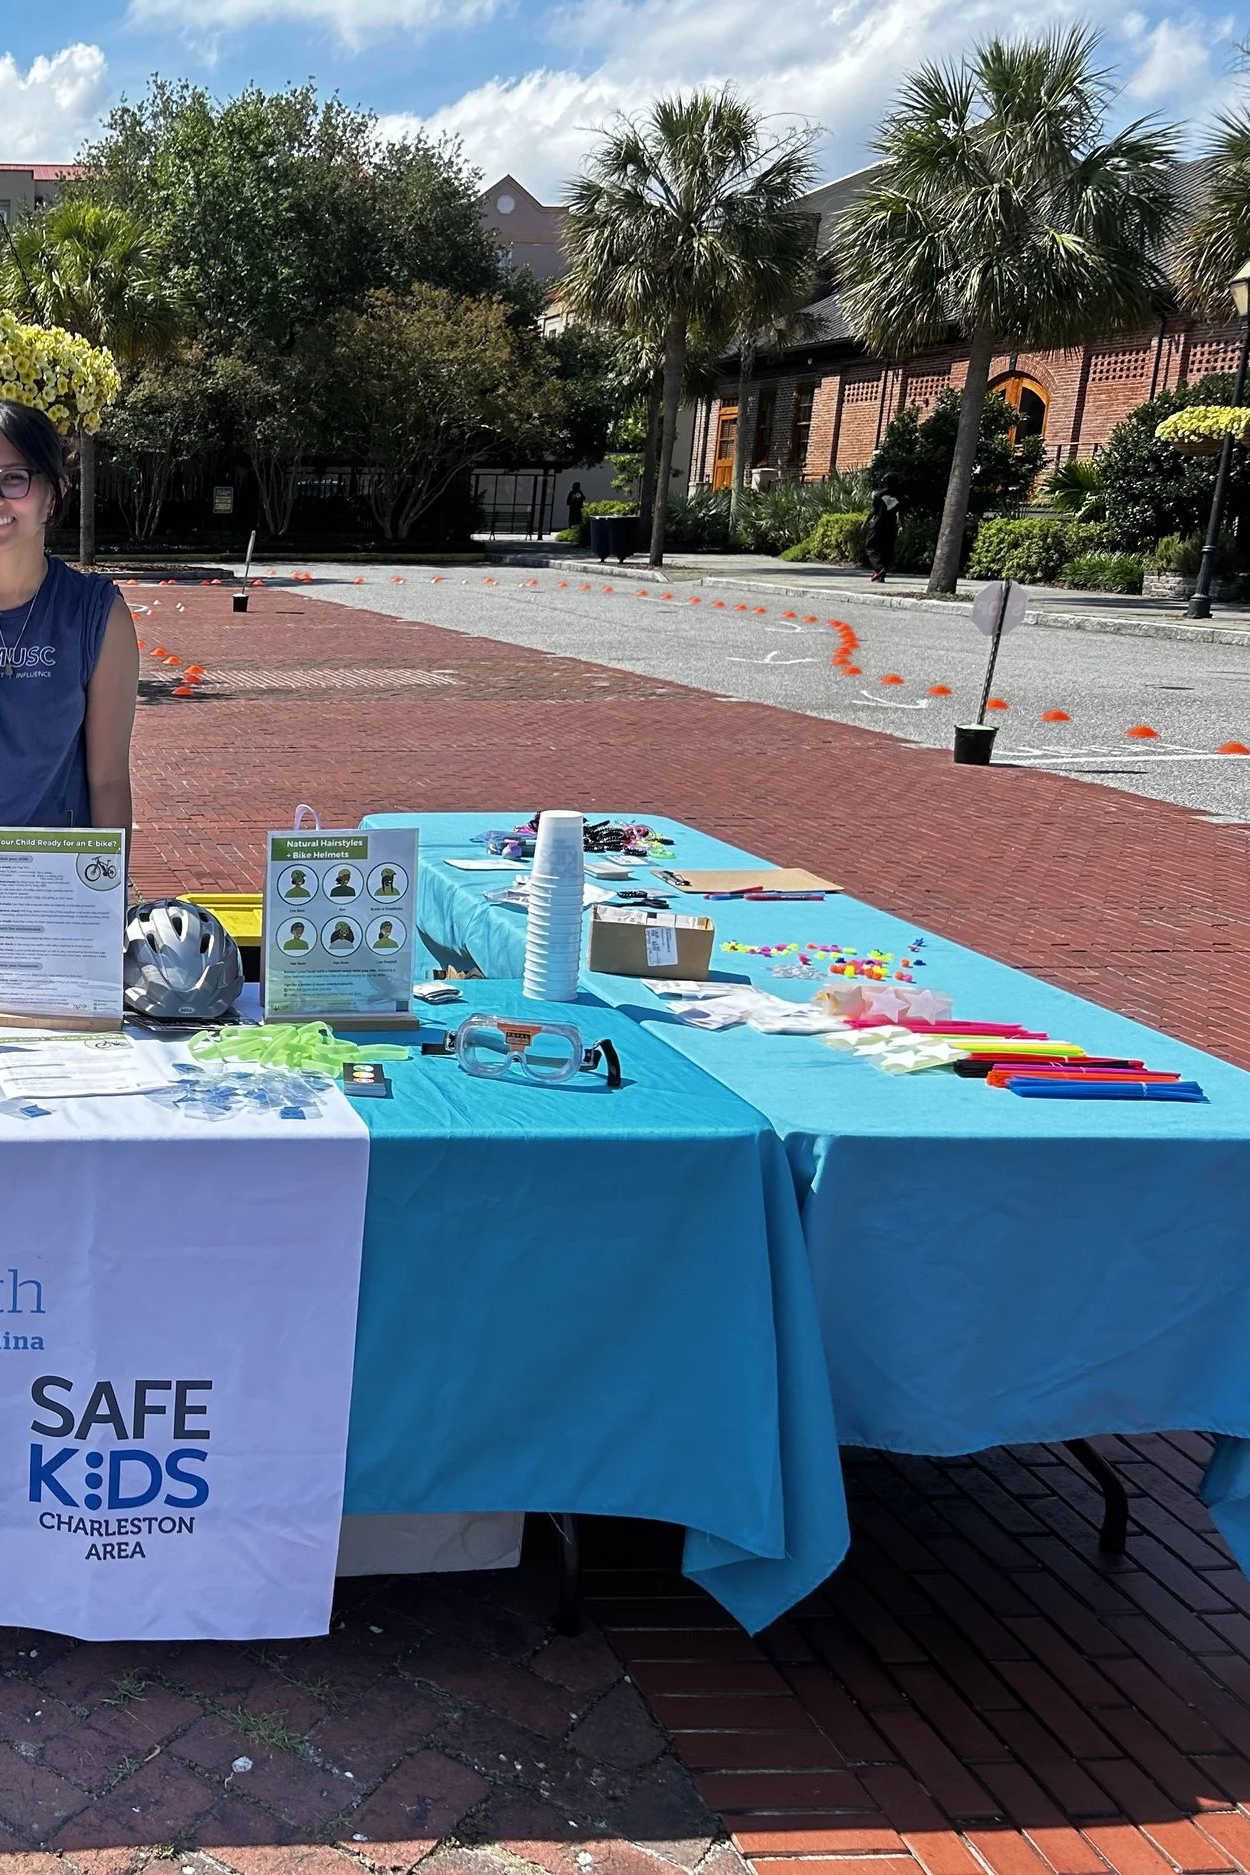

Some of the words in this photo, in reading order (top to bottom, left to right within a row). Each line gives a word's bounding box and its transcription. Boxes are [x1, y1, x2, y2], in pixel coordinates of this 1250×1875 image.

[38, 840, 61, 848] Ready
[321, 839, 363, 848] Hairstyles
[30, 1375, 213, 1441] SAFE
[39, 1511, 195, 1537] CHARLESTON
[85, 1541, 146, 1560] AREA
